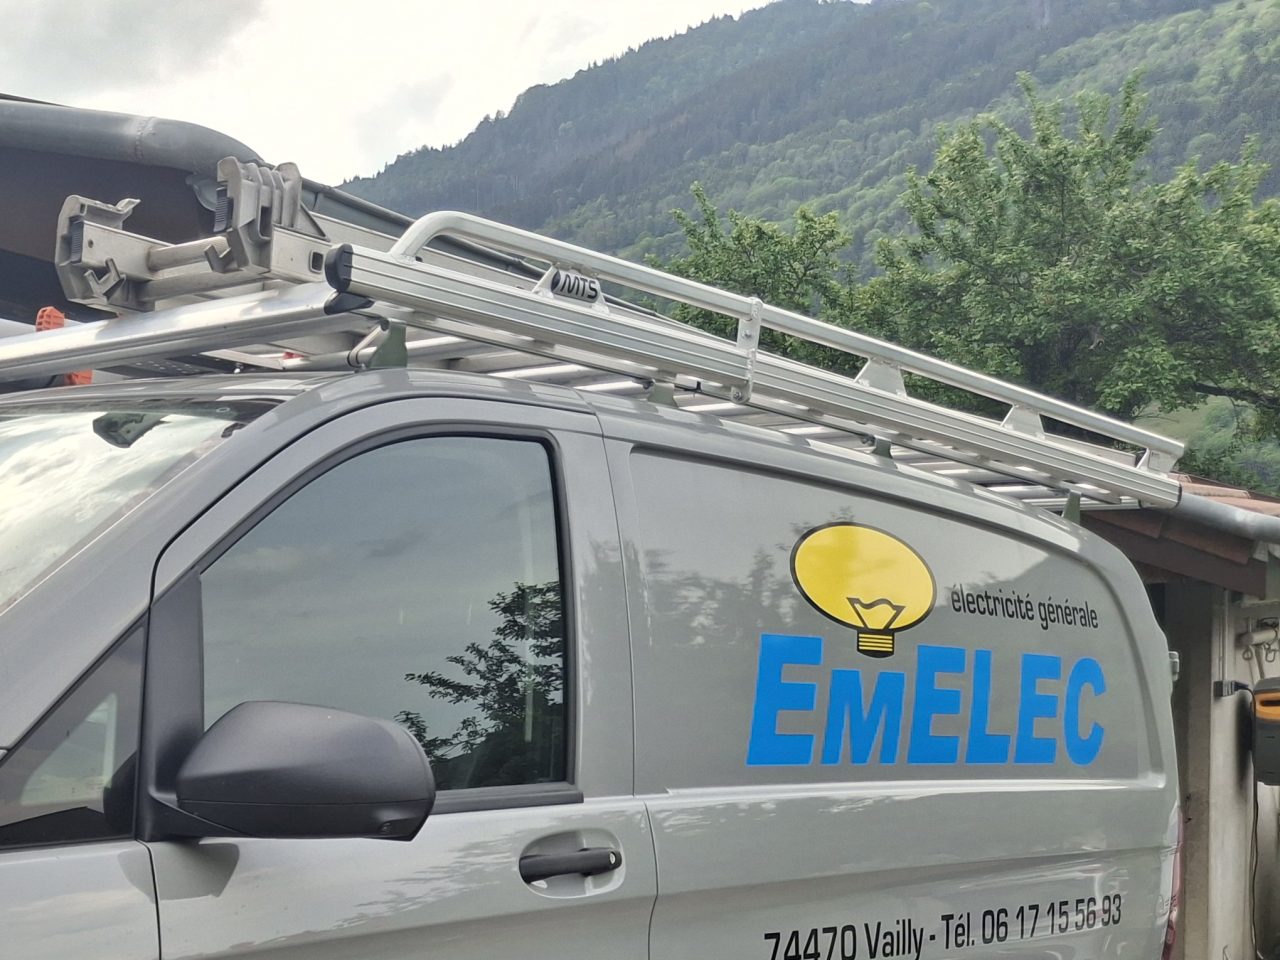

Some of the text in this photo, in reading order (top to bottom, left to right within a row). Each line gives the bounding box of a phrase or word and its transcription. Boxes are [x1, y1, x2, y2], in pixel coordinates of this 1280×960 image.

[560, 274, 598, 299] MTS
[951, 584, 1099, 631] électricité générale
[745, 633, 1107, 766] EMELEC
[941, 913, 975, 950] Tél.
[982, 908, 1009, 945] 06
[1016, 904, 1040, 940] 17
[1047, 901, 1069, 935] 15
[1075, 897, 1097, 931] 56
[1101, 894, 1122, 927] 93
